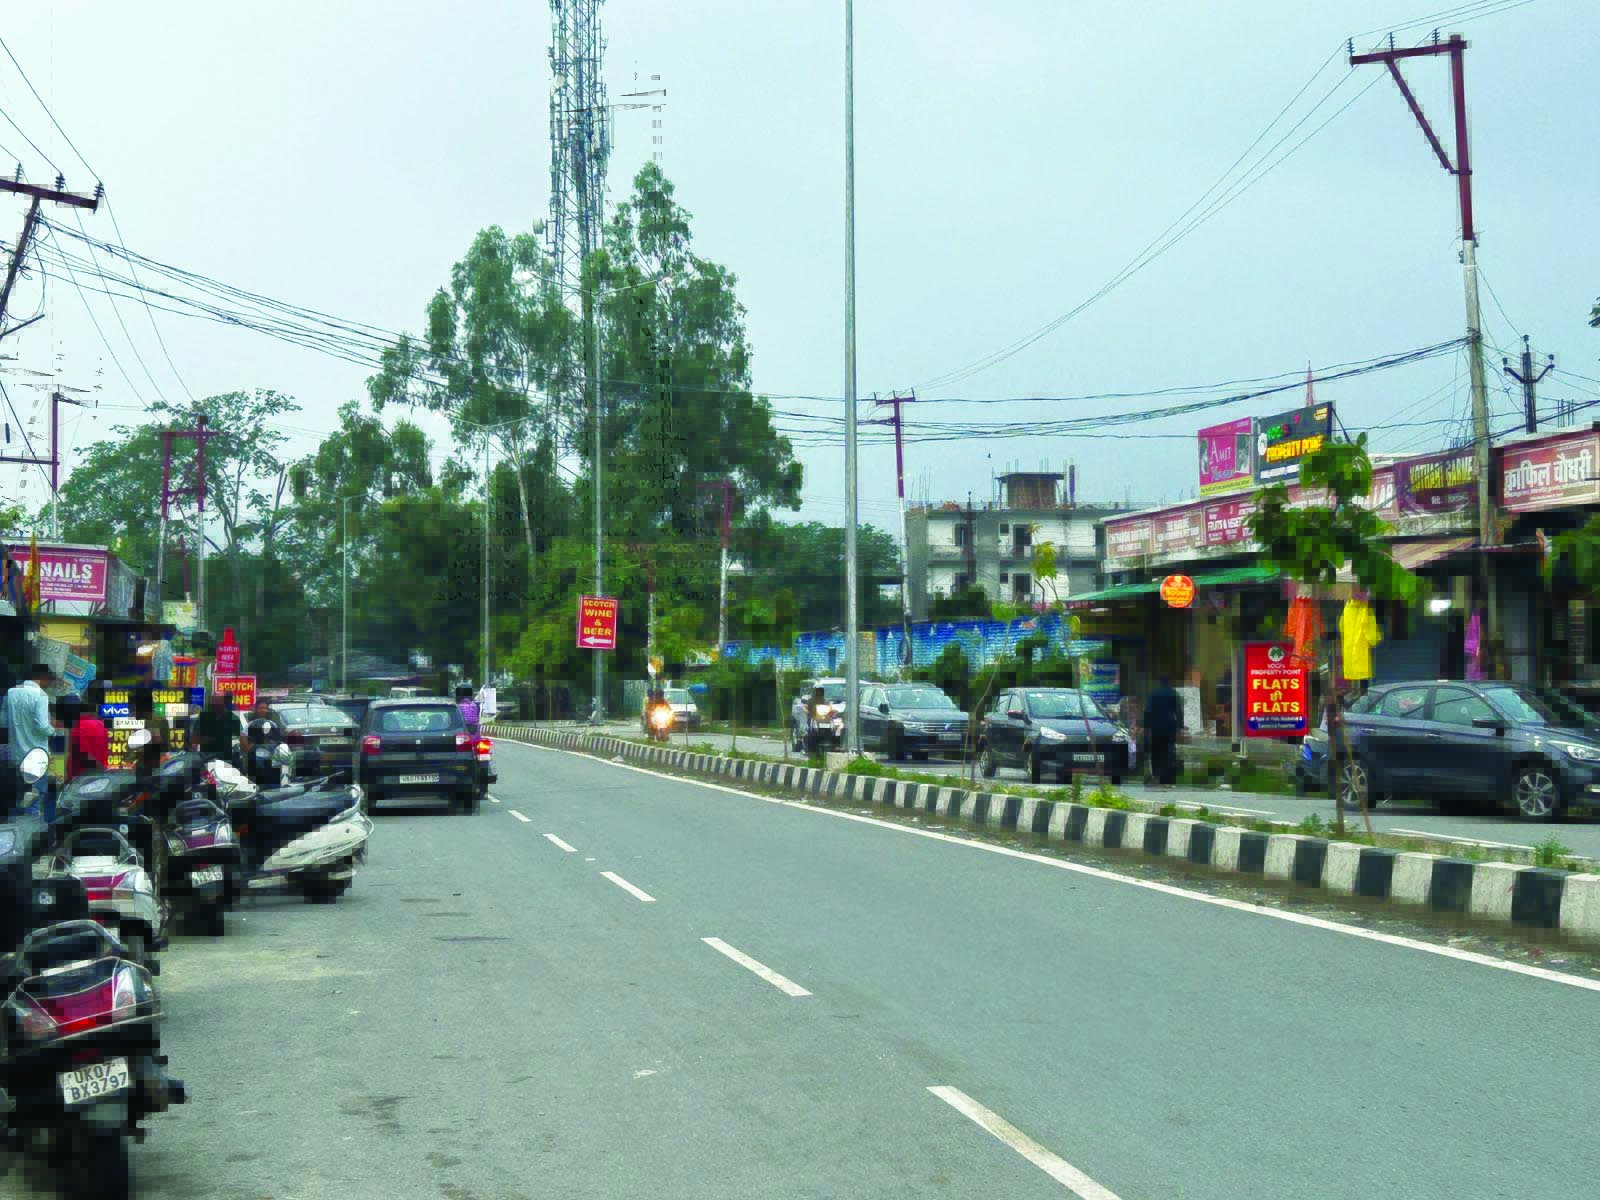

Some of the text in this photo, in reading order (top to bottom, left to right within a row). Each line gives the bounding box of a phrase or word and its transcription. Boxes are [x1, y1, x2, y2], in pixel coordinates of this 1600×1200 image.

[40, 562, 93, 581] NAILS
[584, 600, 615, 608] SCOTCH
[585, 609, 613, 617] WINE
[594, 618, 602, 627] &
[583, 627, 612, 636] BEER
[218, 682, 254, 691] SCOTCH
[1252, 678, 1299, 690] FLATS
[151, 690, 184, 703] SHOP
[231, 695, 251, 705] INE
[1252, 702, 1300, 713] FLATS
[73, 1062, 112, 1084] UK07
[71, 1072, 127, 1101] BX3797
